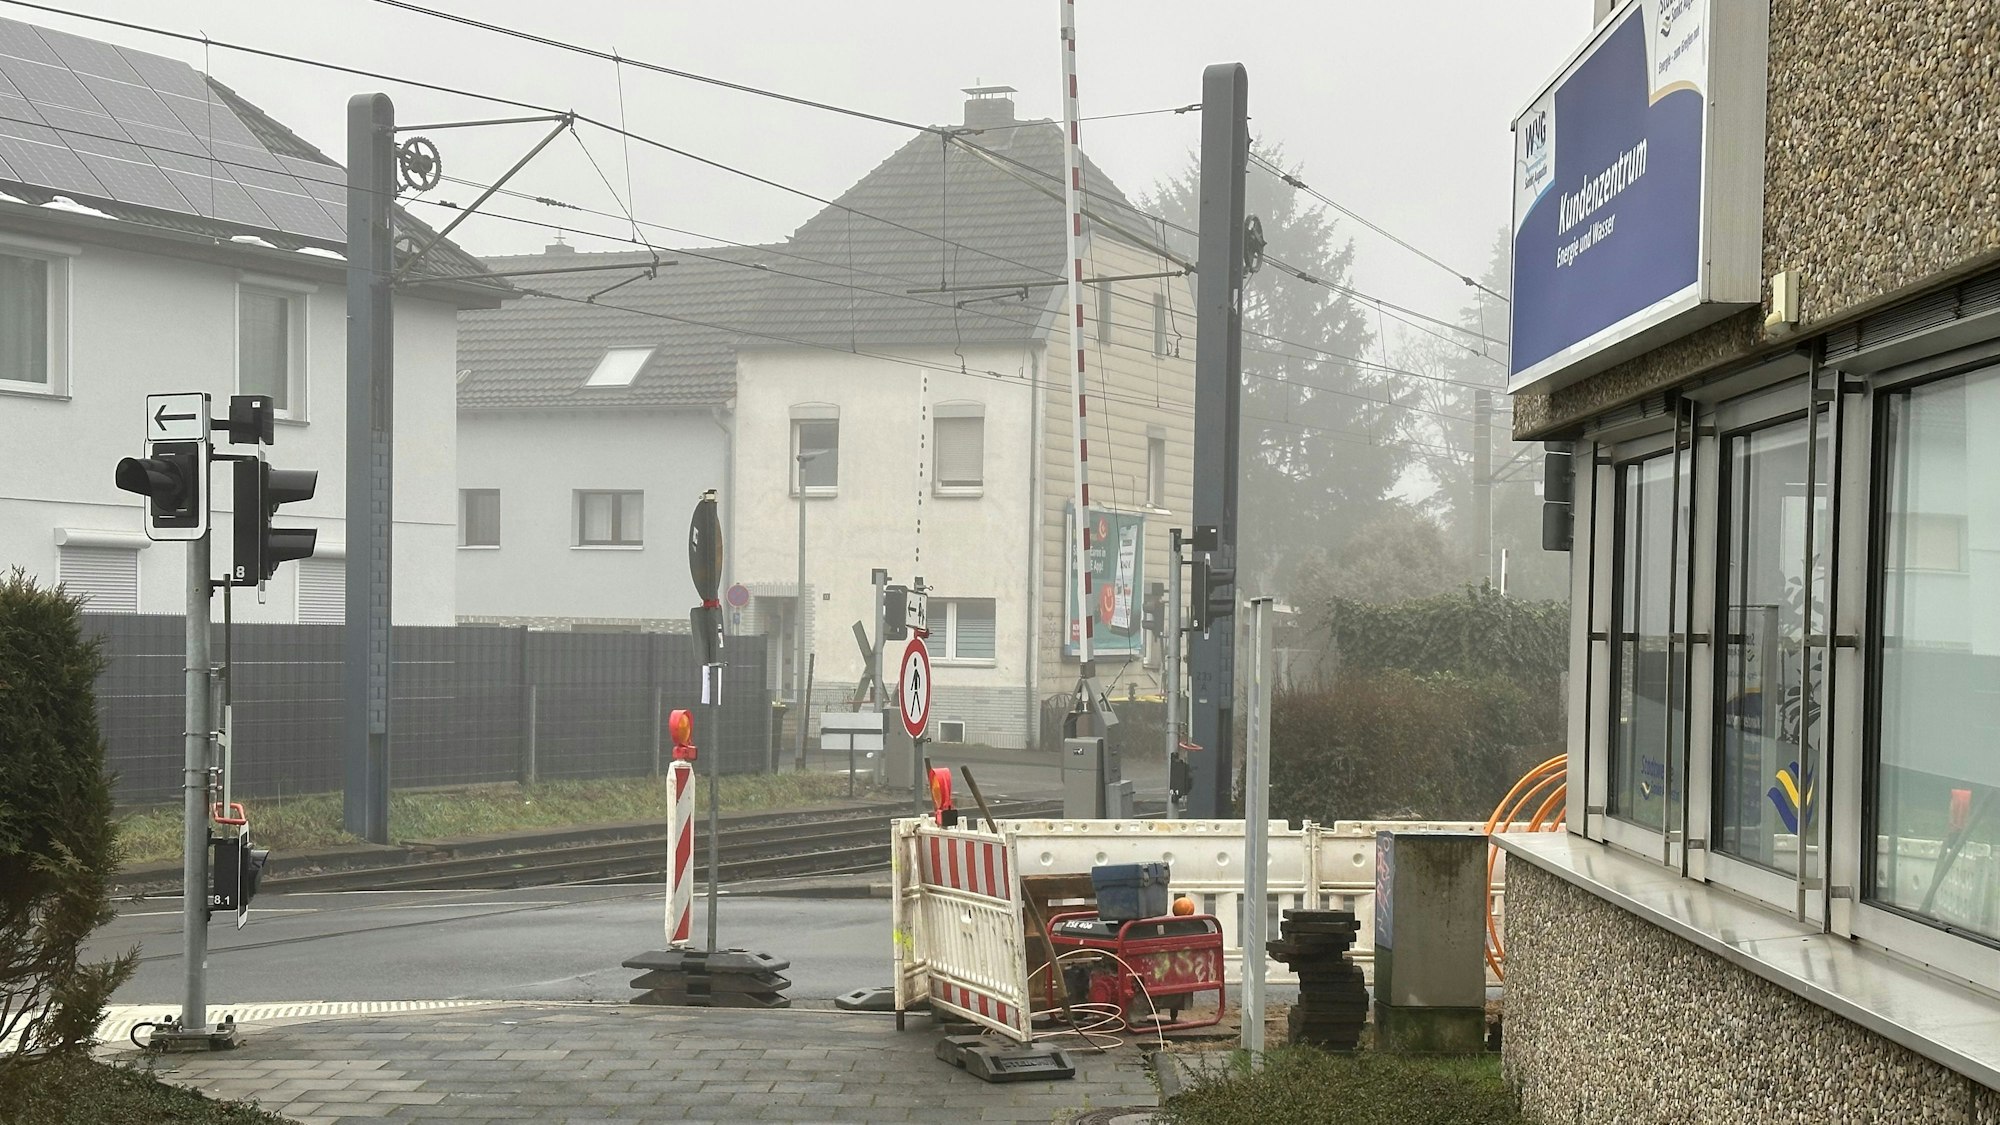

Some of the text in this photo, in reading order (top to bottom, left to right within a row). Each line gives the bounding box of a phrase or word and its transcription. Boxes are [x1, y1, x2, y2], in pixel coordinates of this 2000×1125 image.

[1558, 138, 1648, 236] Kundenzentrum
[1556, 213, 1616, 269] Energie und Wasser
[236, 565, 245, 579] 8
[214, 894, 230, 906] 8.1
